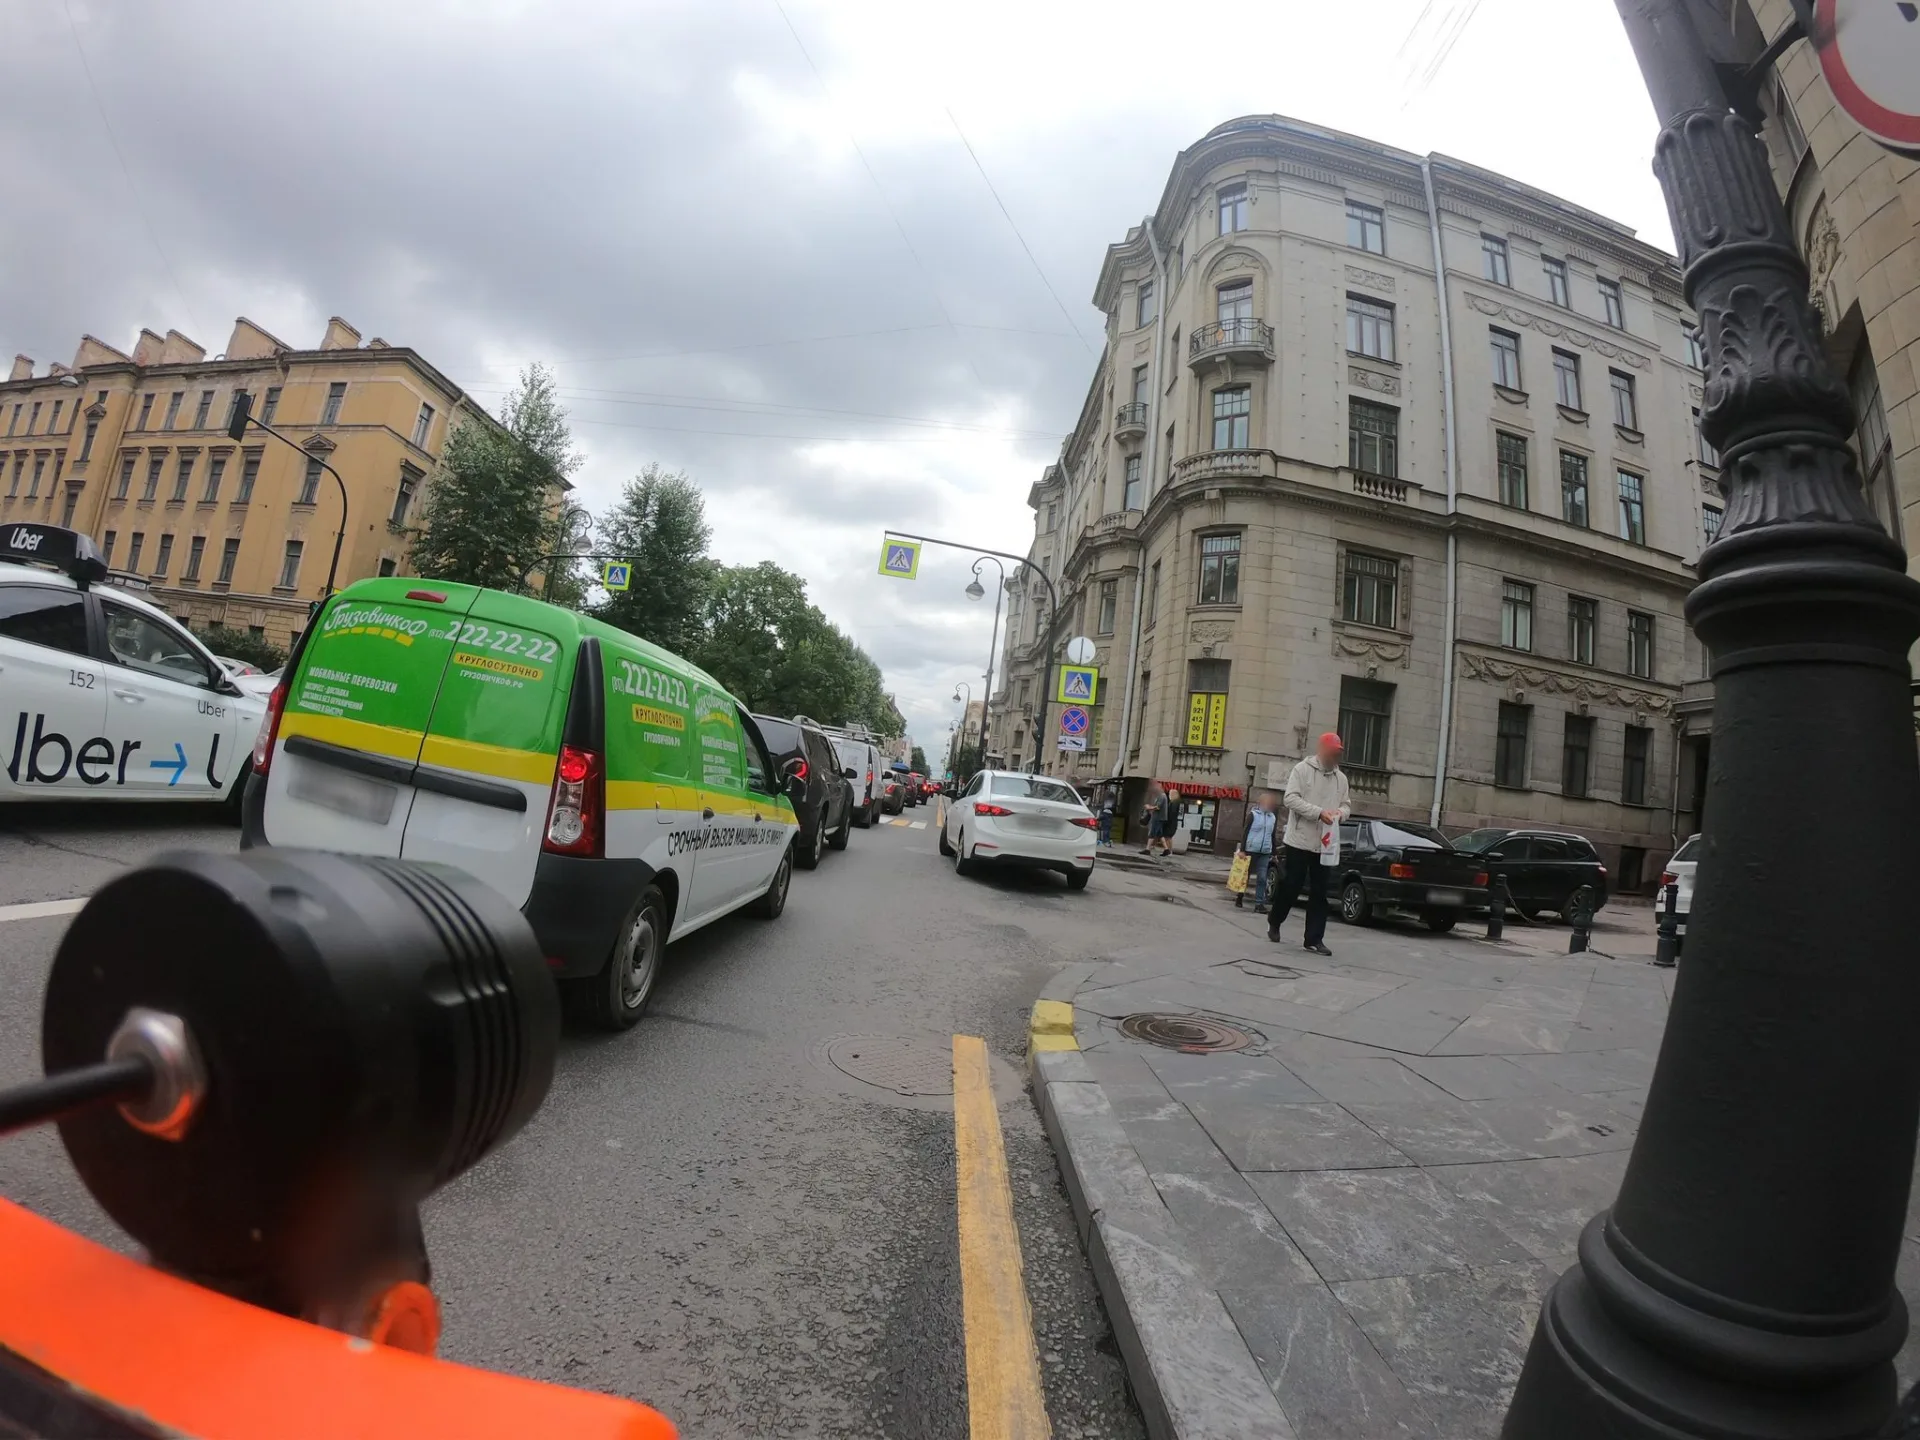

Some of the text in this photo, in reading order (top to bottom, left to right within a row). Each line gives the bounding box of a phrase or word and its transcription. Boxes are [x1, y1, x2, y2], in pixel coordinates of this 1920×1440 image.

[10, 527, 43, 551] Uber
[444, 621, 558, 663] 222-22-22
[458, 655, 539, 679] КРУГЛОСУТОЧНО
[68, 669, 95, 690] 152
[308, 666, 398, 694] МОБИЛЬНЫЕ ПЕРЕВОЗКИ
[621, 660, 690, 710] 222-22-22
[198, 700, 226, 719] Uber
[635, 707, 684, 729] КРУГЛОСУТОЧНО
[667, 824, 712, 857] СРОЧНЫЙ
[709, 827, 736, 848] ВЫЗОВ
